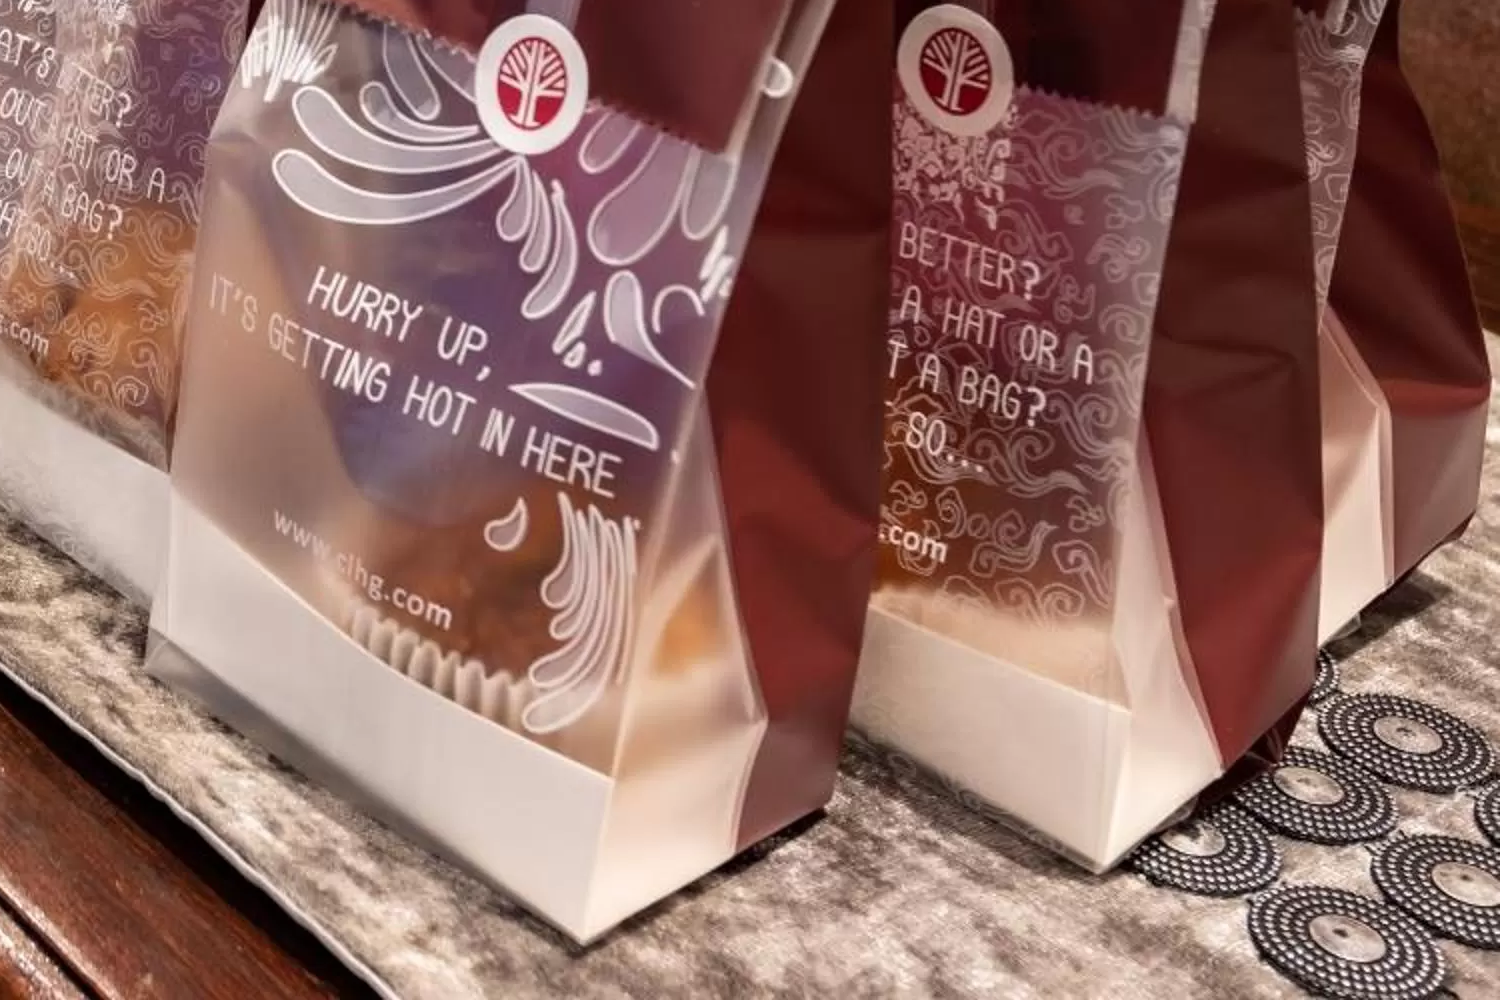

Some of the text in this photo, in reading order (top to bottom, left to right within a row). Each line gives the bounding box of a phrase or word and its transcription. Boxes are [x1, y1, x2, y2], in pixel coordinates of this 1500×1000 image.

[0, 87, 48, 133] OUT
[105, 149, 134, 193] OR
[147, 166, 166, 204] A
[61, 183, 124, 241] BAG?
[899, 221, 1041, 300] BETTER?
[306, 266, 491, 382] HURRY UP,
[900, 285, 1094, 385] A HAT OR A
[209, 272, 623, 499] IT'S GETTING HOT IN HERE
[918, 353, 941, 393] A
[959, 367, 1047, 428] BAG?
